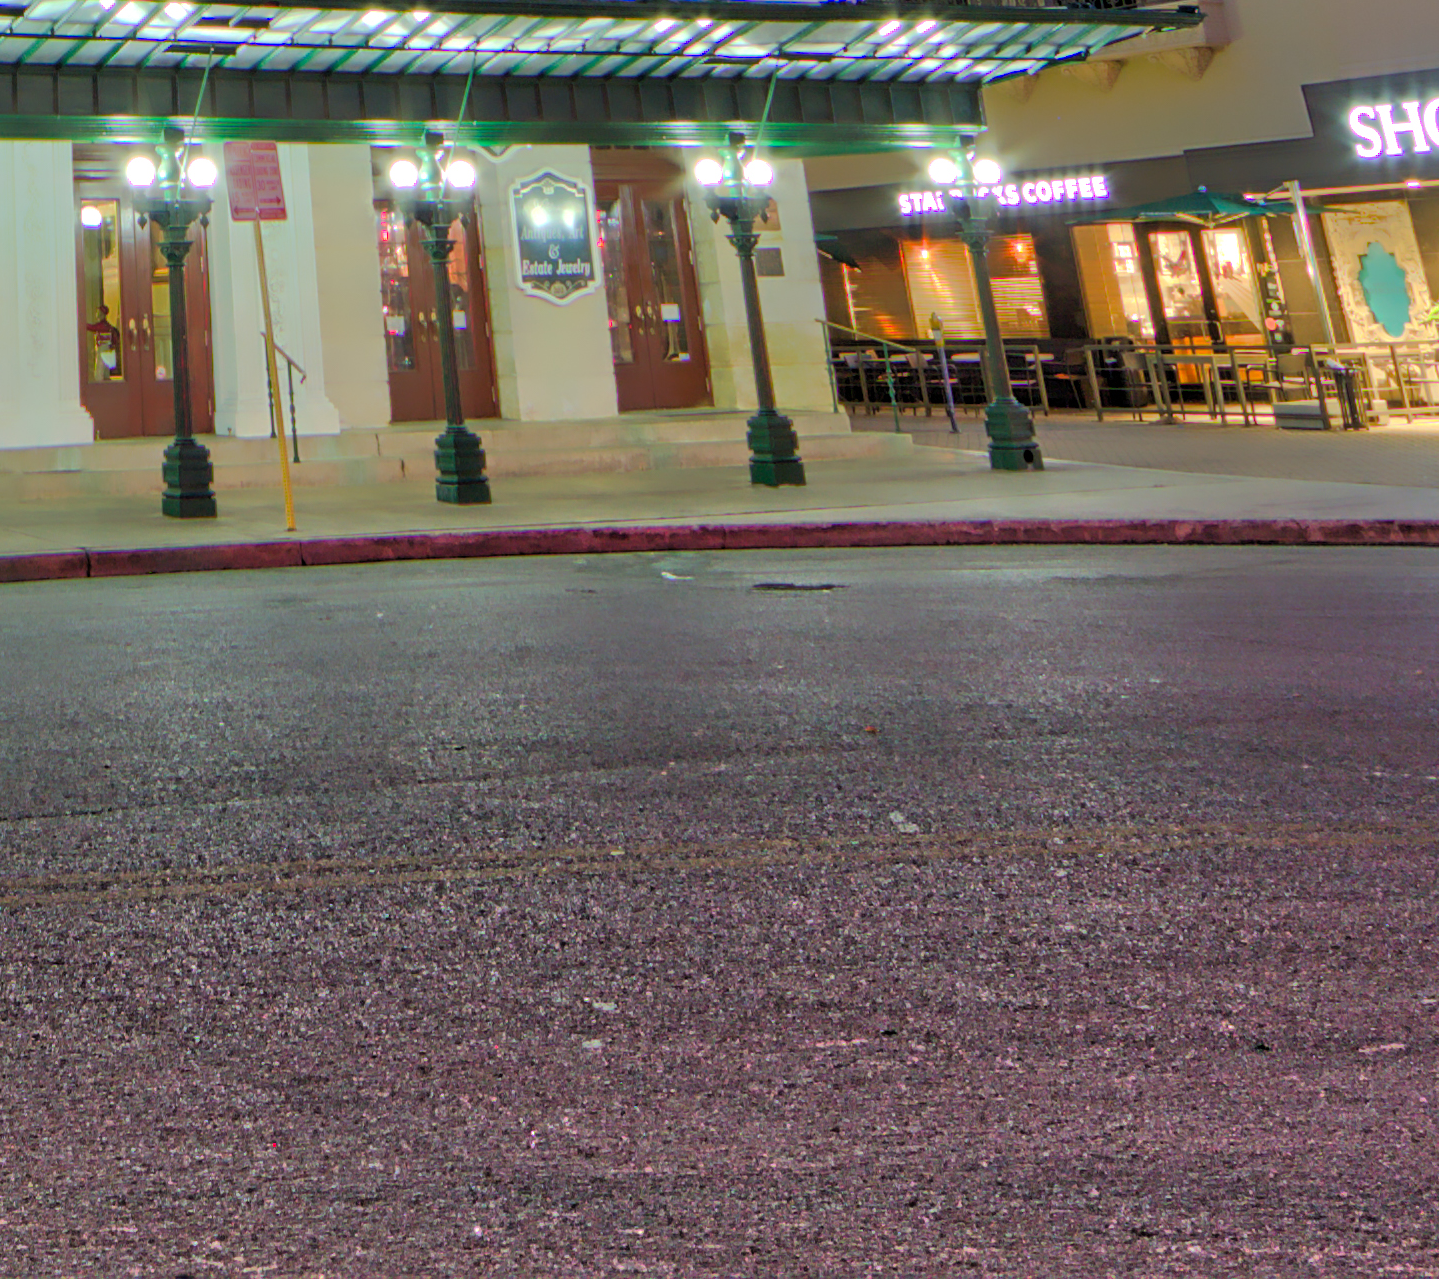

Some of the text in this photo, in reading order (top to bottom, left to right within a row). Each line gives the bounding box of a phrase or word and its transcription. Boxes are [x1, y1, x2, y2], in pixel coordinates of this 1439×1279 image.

[899, 175, 1109, 216] STARKS COFFEE
[548, 244, 560, 259] &
[522, 258, 591, 276] Estate Jewelry
